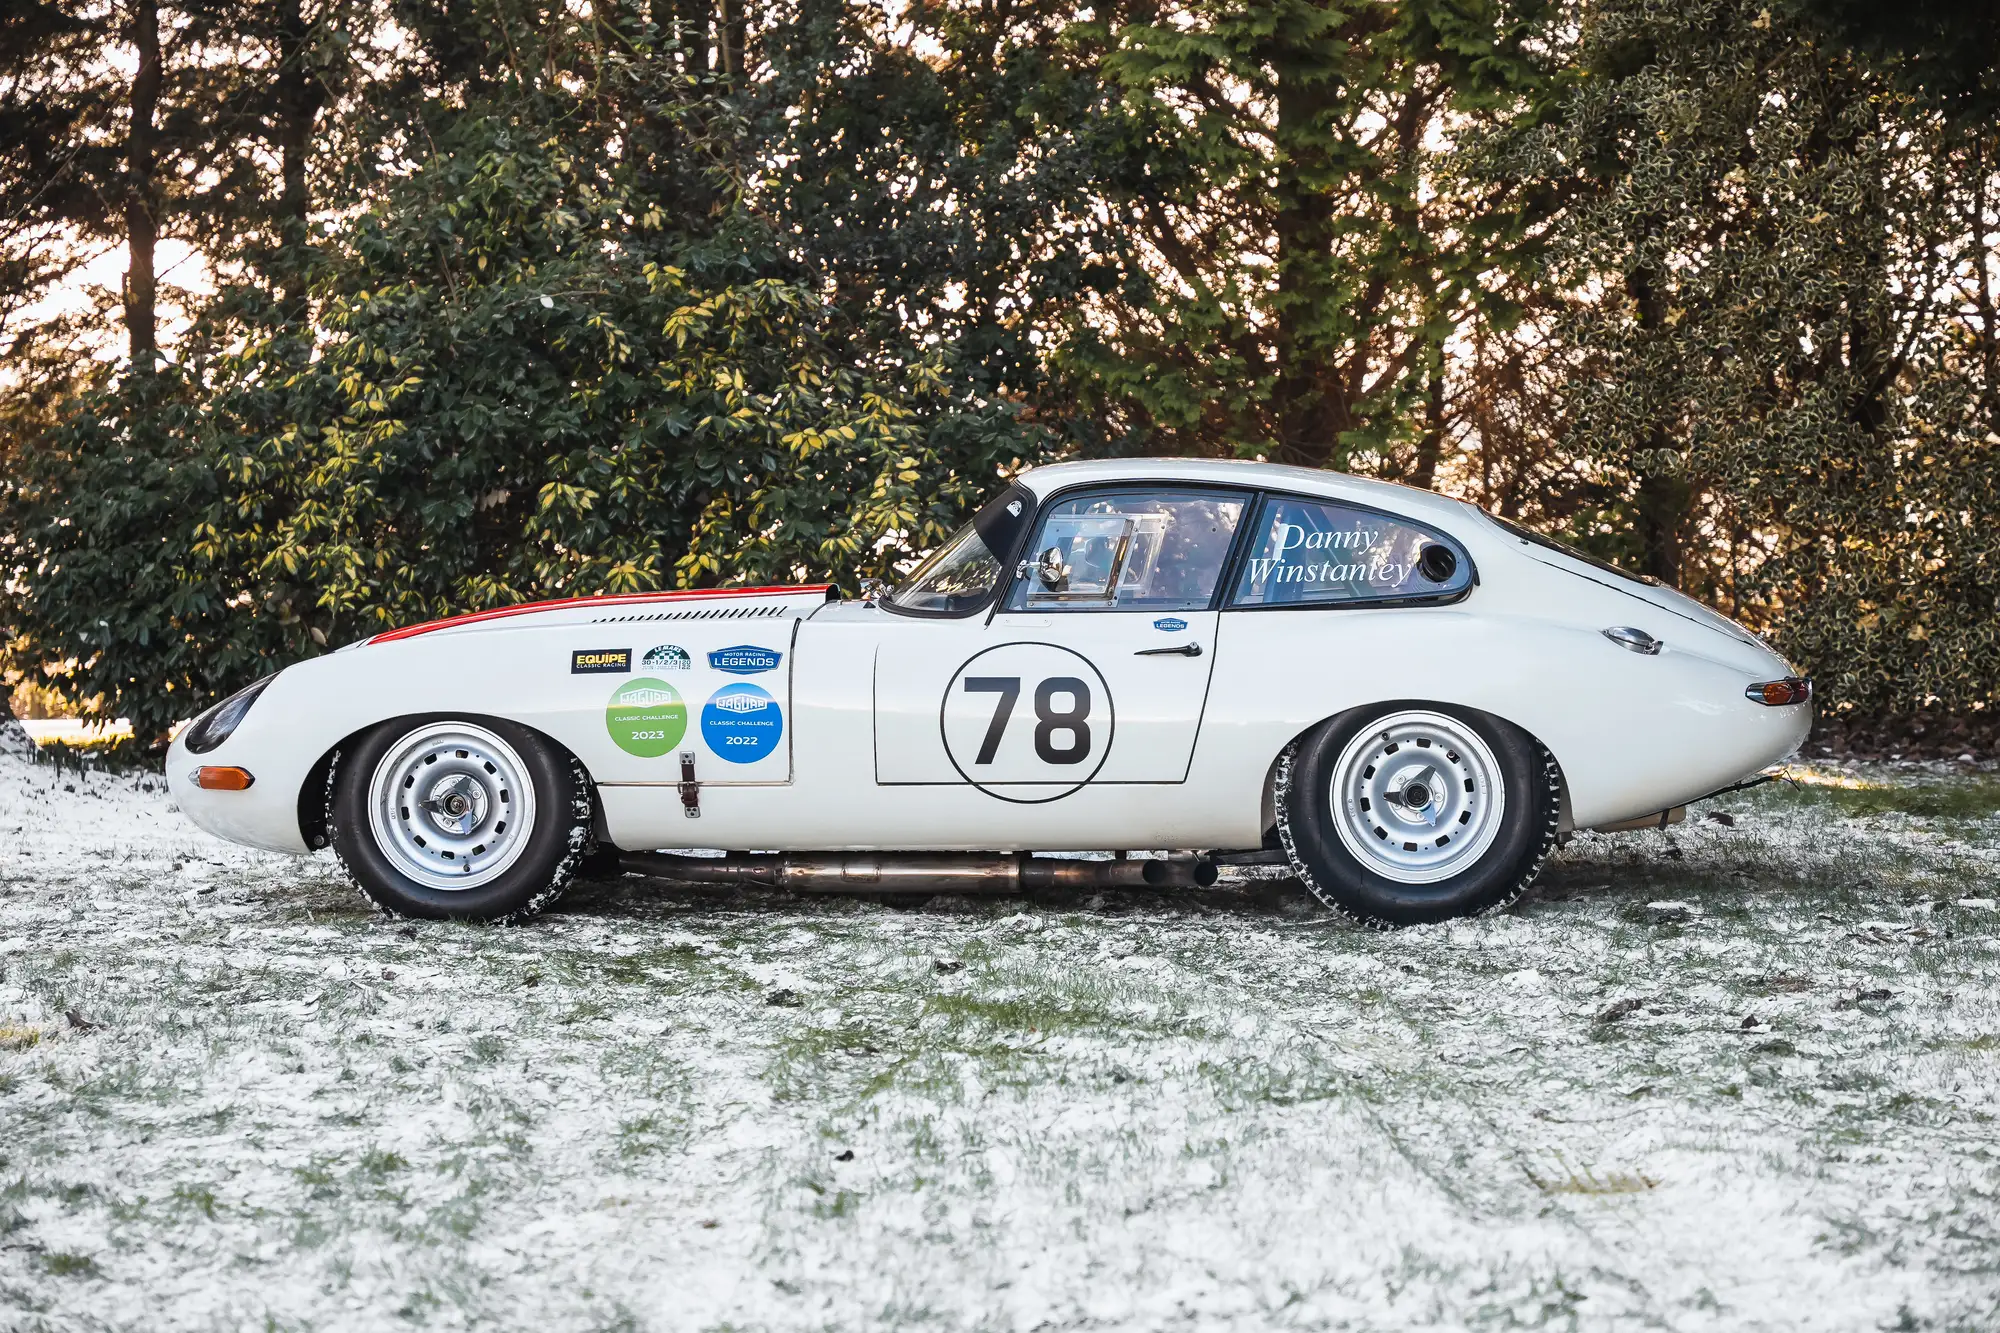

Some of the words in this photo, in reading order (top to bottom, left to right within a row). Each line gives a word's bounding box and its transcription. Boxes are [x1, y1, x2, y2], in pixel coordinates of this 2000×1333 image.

[1281, 524, 1379, 555] Danny
[1250, 558, 1412, 588] Winstanley
[576, 653, 627, 665] EQUIPE
[714, 657, 774, 666] LEGENDS
[621, 690, 669, 705] JAGUAR
[717, 695, 765, 711] JAGUAR
[964, 677, 1091, 764] 78
[631, 730, 665, 740] 2023
[725, 736, 759, 745] 2022
